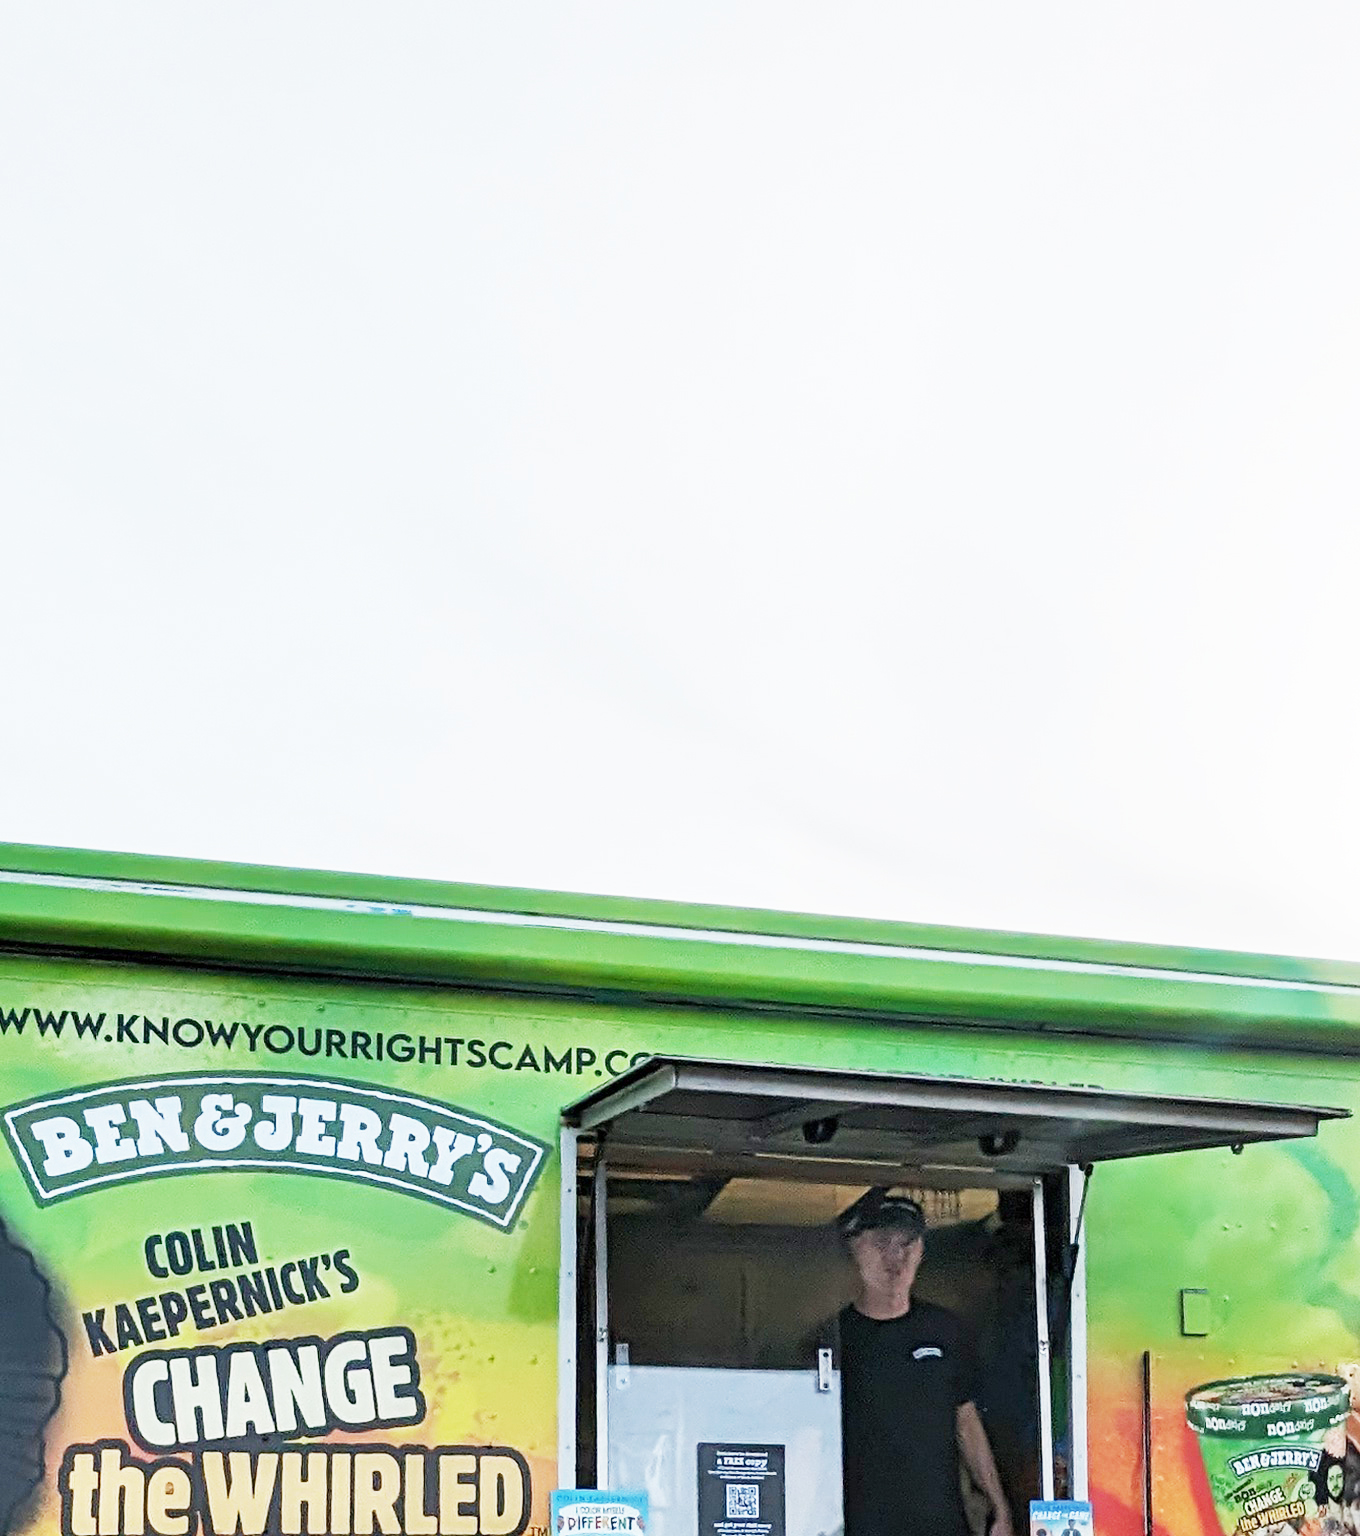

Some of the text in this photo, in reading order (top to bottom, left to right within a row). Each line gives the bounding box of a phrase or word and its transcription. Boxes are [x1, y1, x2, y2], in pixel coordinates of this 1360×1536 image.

[144, 1220, 259, 1279] COLIN
[82, 1249, 360, 1358] KAEPERNICK'S
[128, 1330, 420, 1447] CHANGE
[568, 1516, 635, 1531] DIFFERENT
[1240, 1501, 1305, 1532] the WHIRLED
[1244, 1487, 1286, 1515] CHANGE
